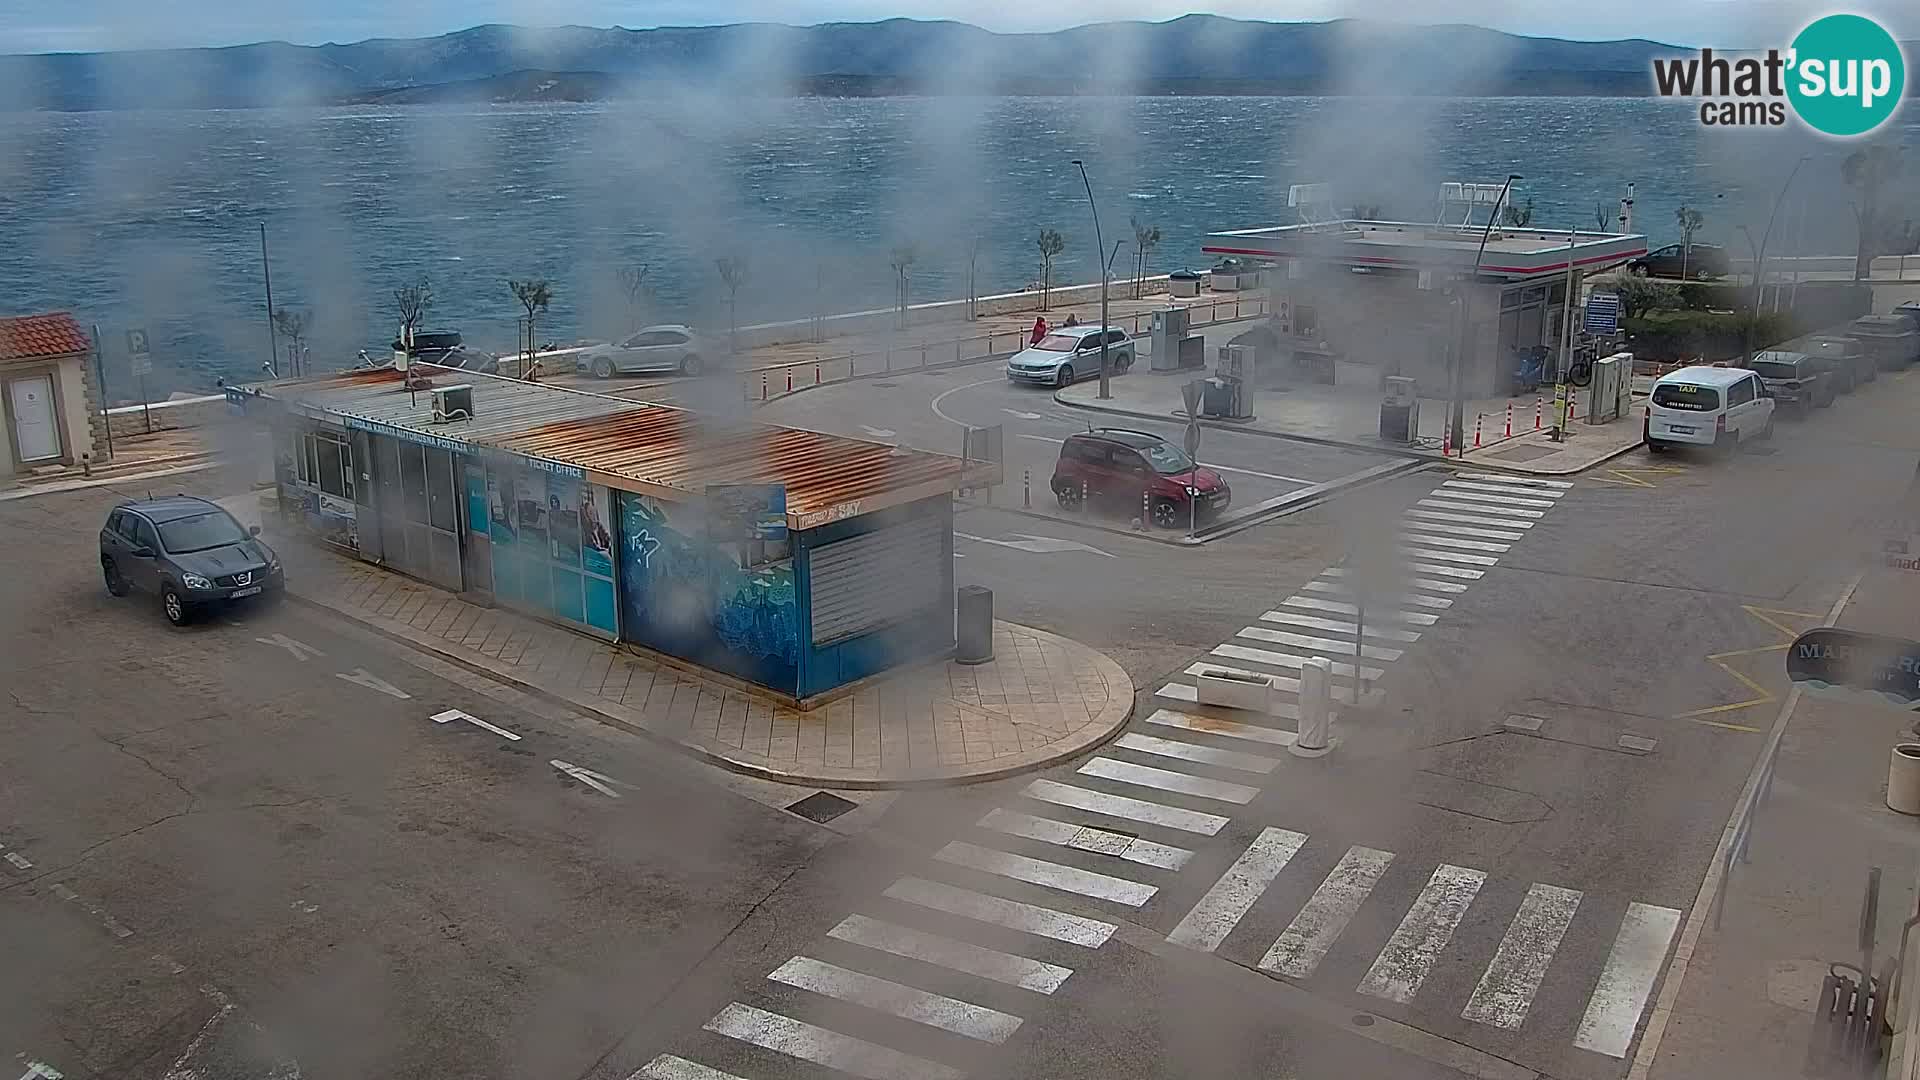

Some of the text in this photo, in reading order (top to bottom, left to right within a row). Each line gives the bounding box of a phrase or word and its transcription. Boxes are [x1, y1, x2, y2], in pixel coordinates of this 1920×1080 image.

[1679, 385, 1697, 393] TAXI
[437, 438, 467, 452] POSTAJA
[528, 458, 555, 472] TICKET
[556, 464, 582, 478] OFFICE
